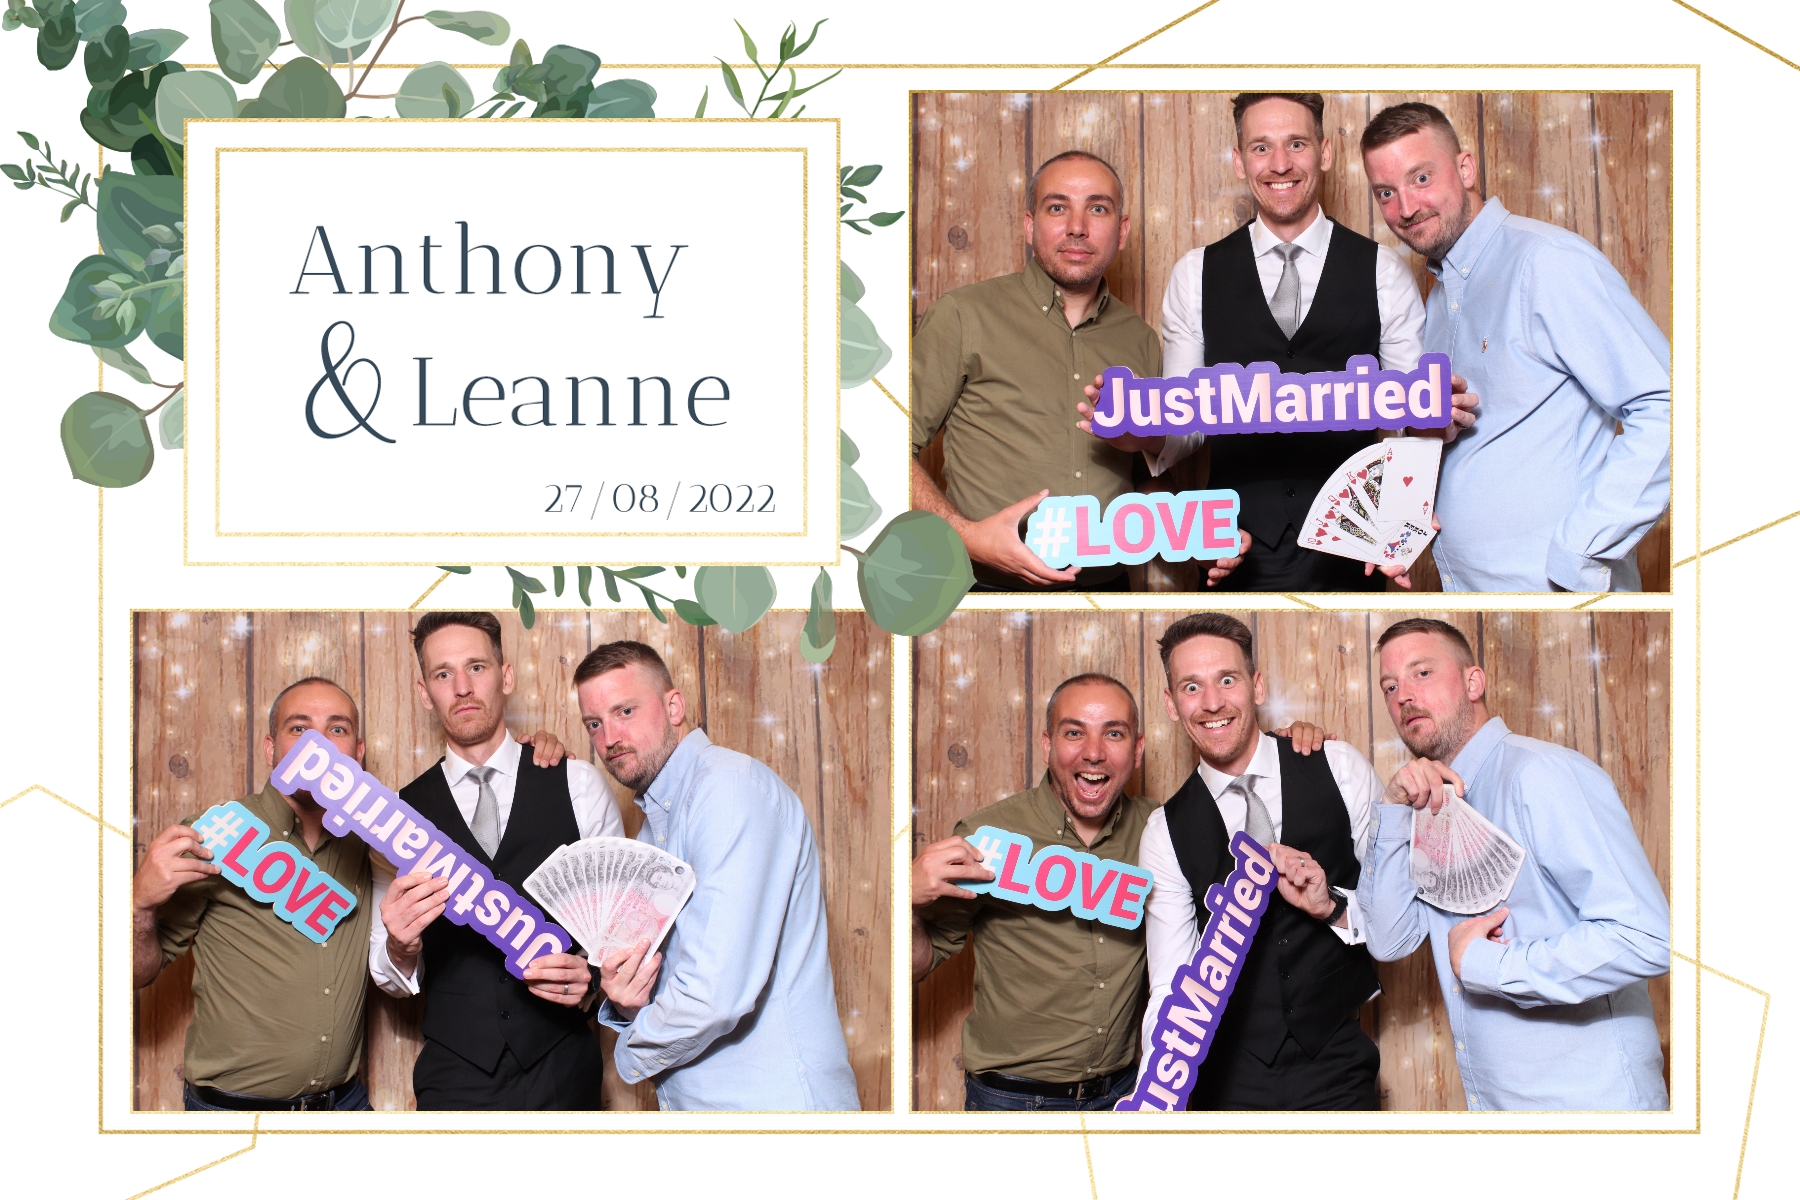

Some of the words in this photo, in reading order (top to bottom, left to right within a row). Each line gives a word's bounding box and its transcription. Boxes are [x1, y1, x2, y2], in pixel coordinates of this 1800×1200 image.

[1094, 363, 1442, 428] JustMarried
[1033, 500, 1235, 559] #LOVE
[199, 810, 348, 934] #LOVE
[281, 739, 563, 970] JustMarried
[977, 836, 1147, 920] #LOVE
